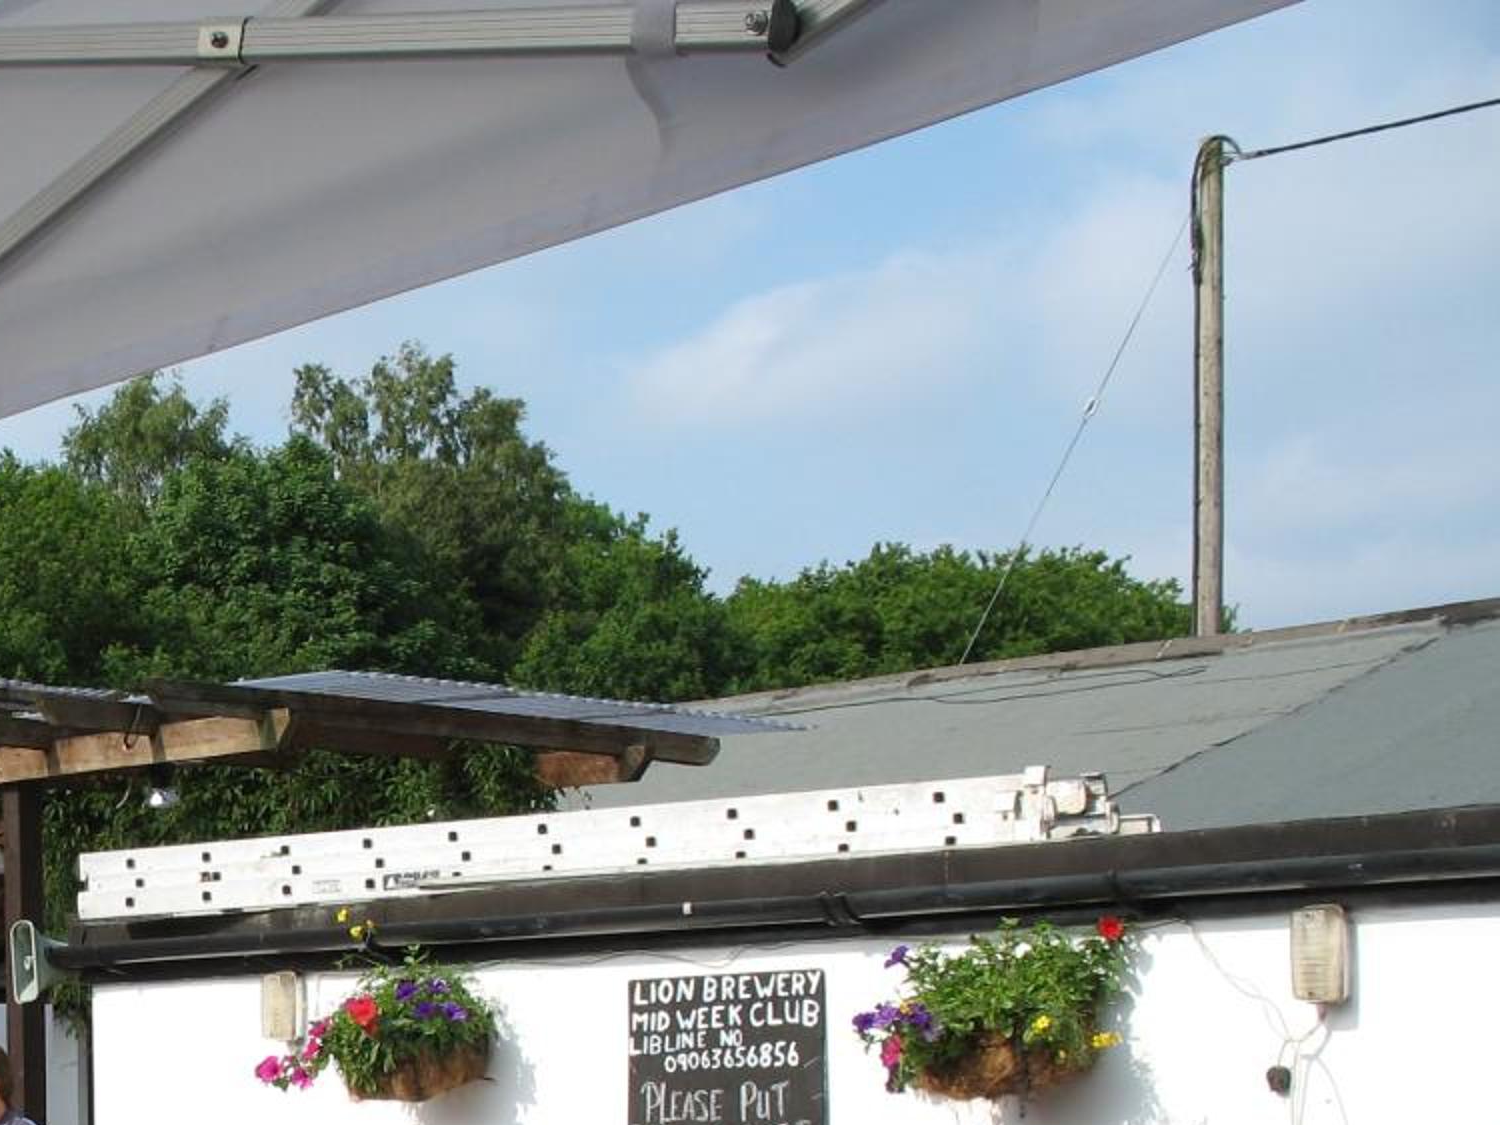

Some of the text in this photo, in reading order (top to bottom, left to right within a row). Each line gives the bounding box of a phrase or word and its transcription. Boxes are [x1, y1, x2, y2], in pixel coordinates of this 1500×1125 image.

[633, 970, 821, 1005] LION BREWERY
[632, 999, 820, 1032] MID WEEK CLUB
[719, 1029, 743, 1047] NO
[664, 1041, 799, 1073] 09063656856
[640, 1081, 724, 1124] PLEASE
